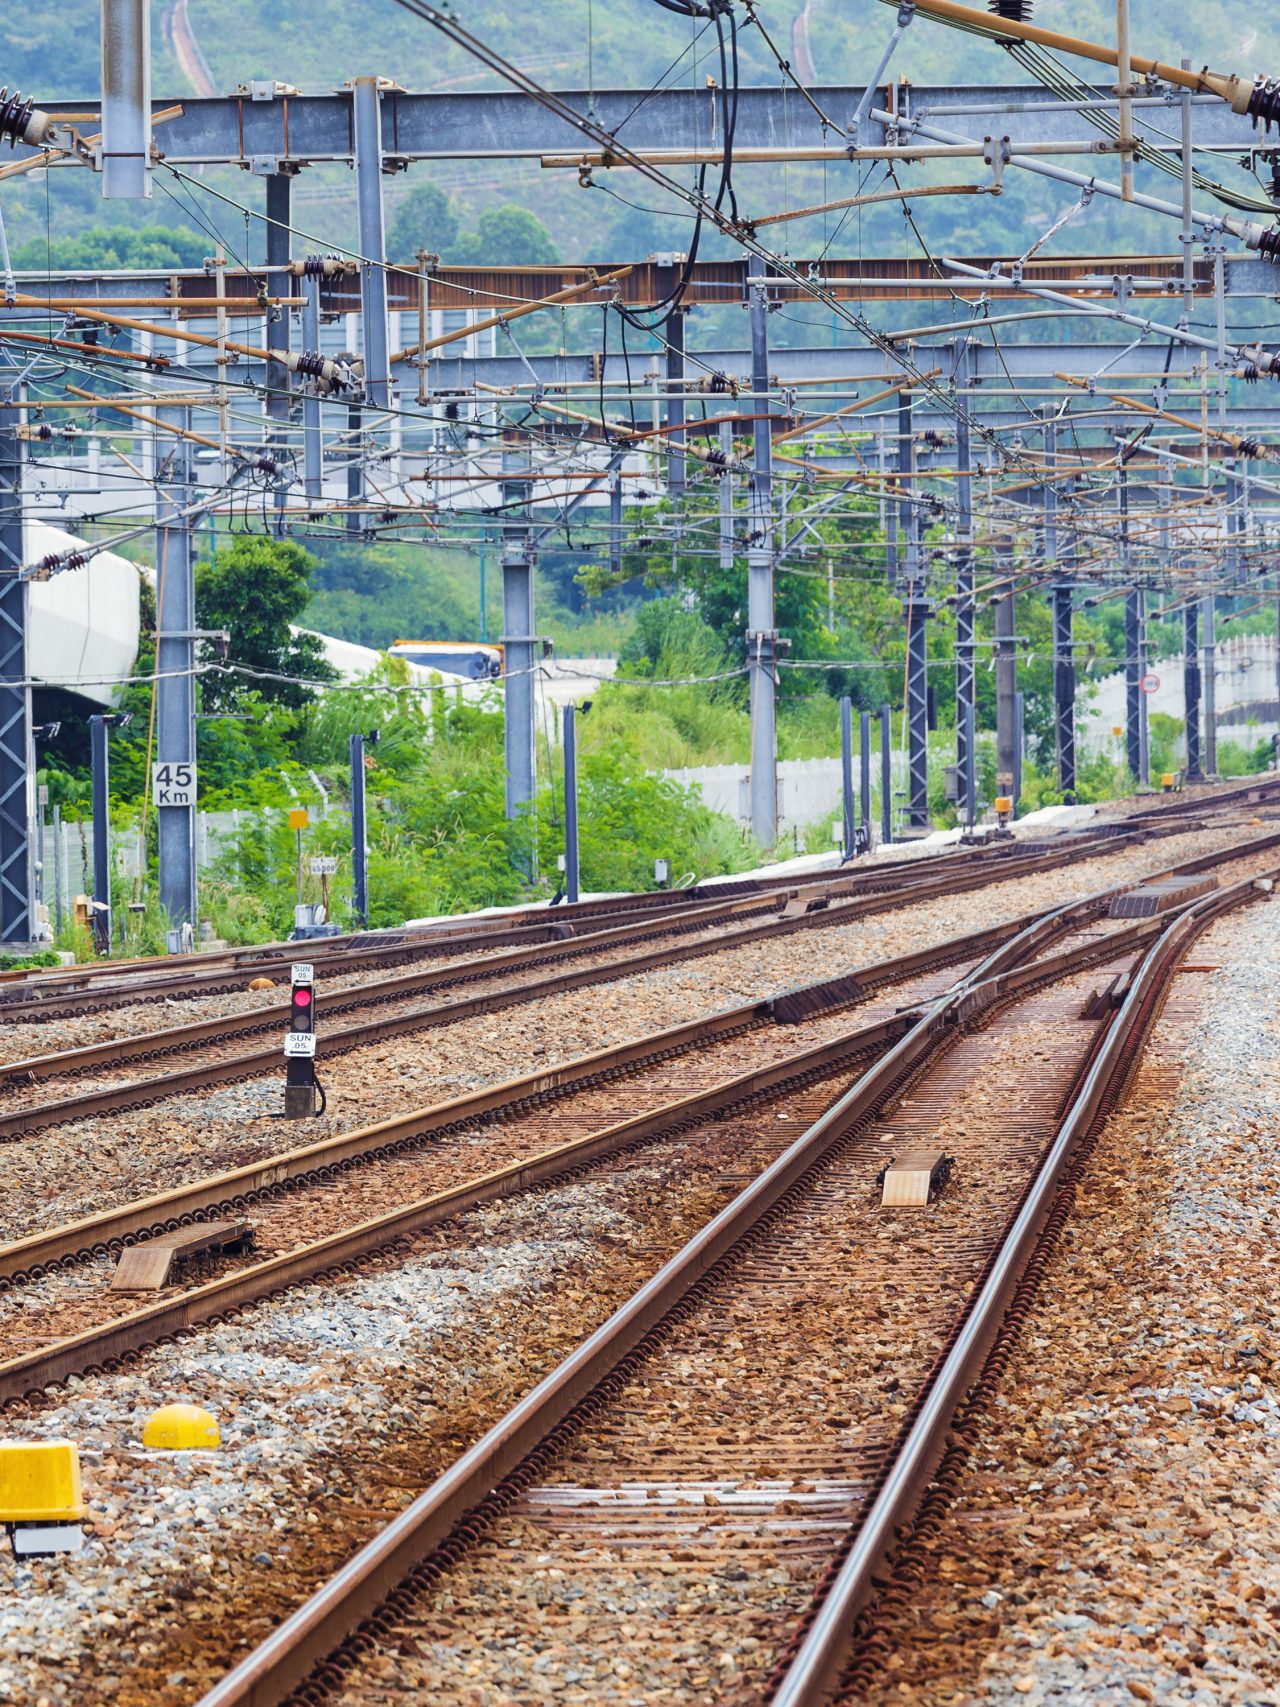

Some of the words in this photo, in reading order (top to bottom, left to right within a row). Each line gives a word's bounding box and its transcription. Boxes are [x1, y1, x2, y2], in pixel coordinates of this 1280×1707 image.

[156, 765, 192, 787] 45
[159, 789, 189, 803] Km
[290, 1034, 312, 1042] SUN
